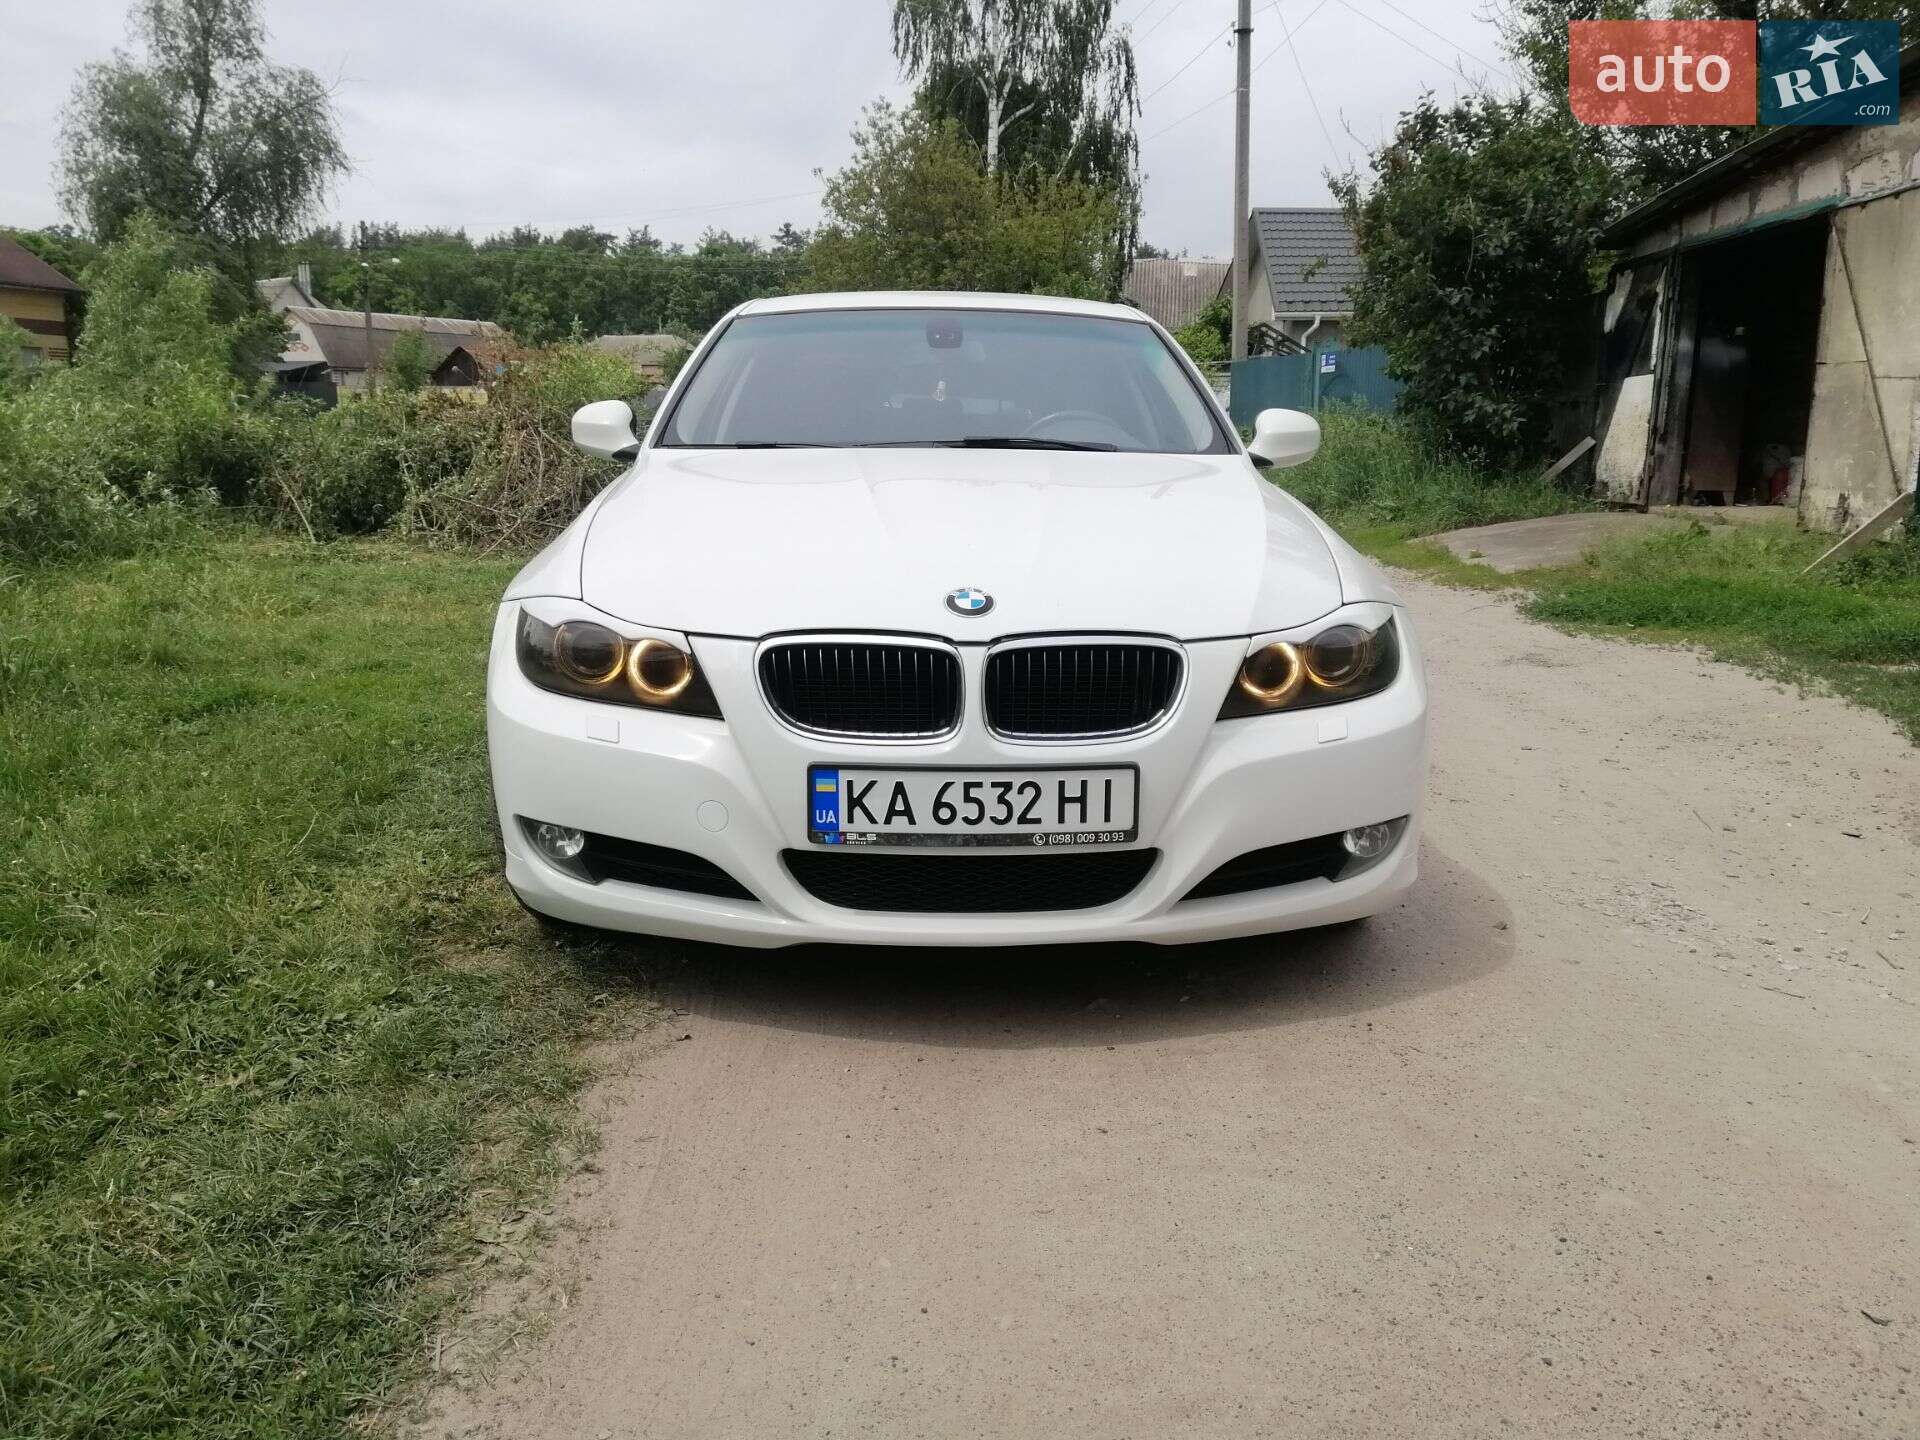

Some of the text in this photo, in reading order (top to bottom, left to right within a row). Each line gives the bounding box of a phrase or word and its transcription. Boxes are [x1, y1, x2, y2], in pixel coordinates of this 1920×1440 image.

[846, 778, 1112, 825] KA 6532 HI
[816, 809, 837, 824] UA
[1049, 832, 1124, 845] (098) 009 30 93
